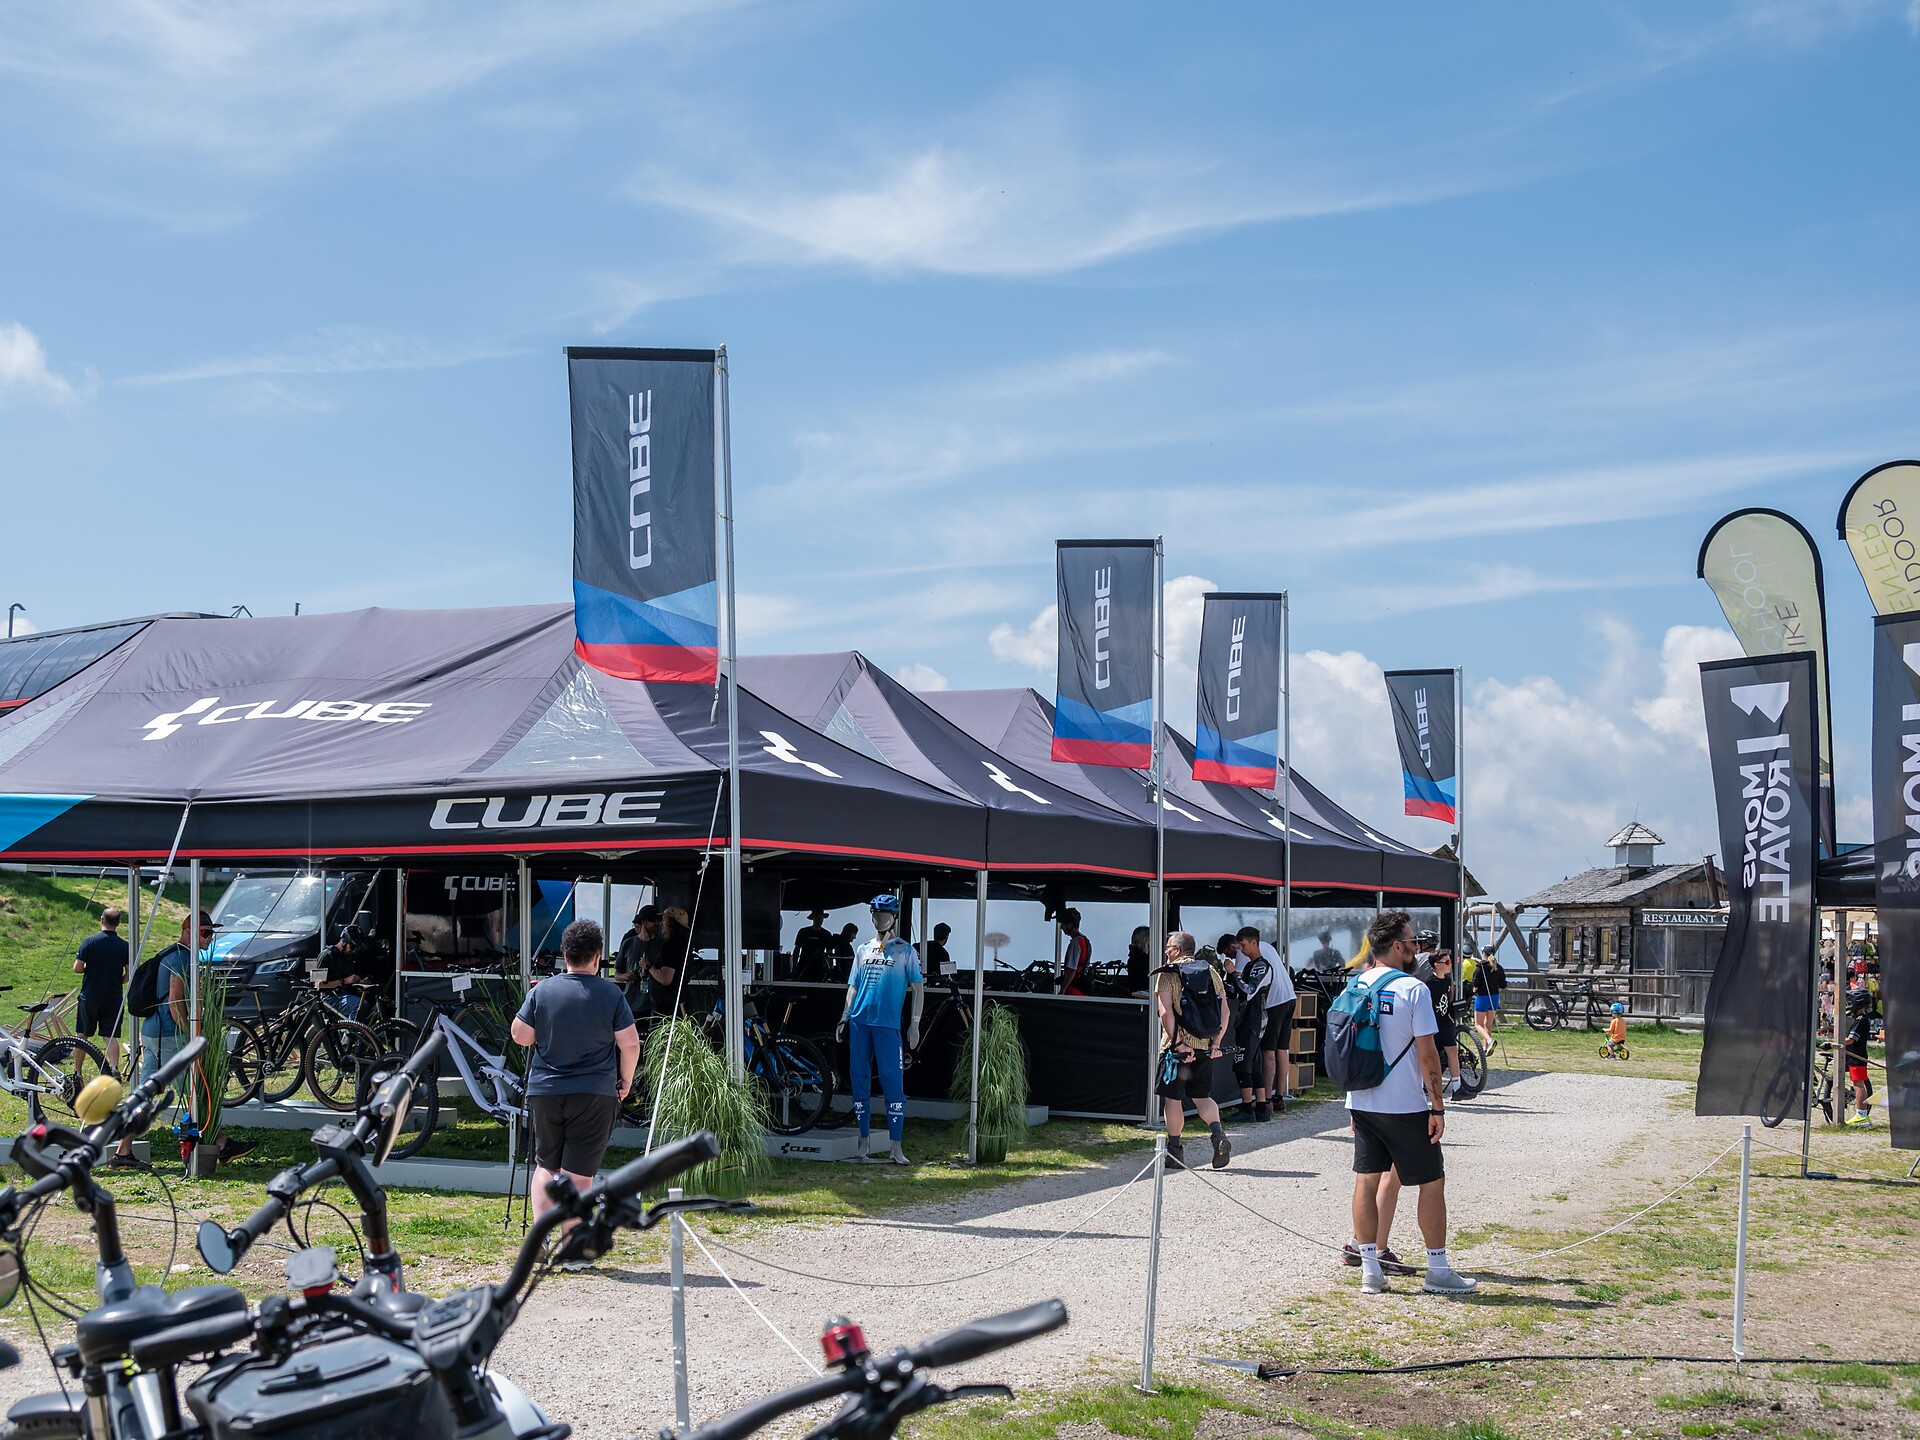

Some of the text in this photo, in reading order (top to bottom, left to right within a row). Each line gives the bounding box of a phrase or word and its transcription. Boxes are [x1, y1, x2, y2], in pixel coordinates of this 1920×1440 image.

[197, 698, 433, 727] CUBE
[430, 790, 666, 830] CUBE
[1644, 913, 1715, 923] RESTAURANT
[790, 1145, 821, 1154] CUBE
